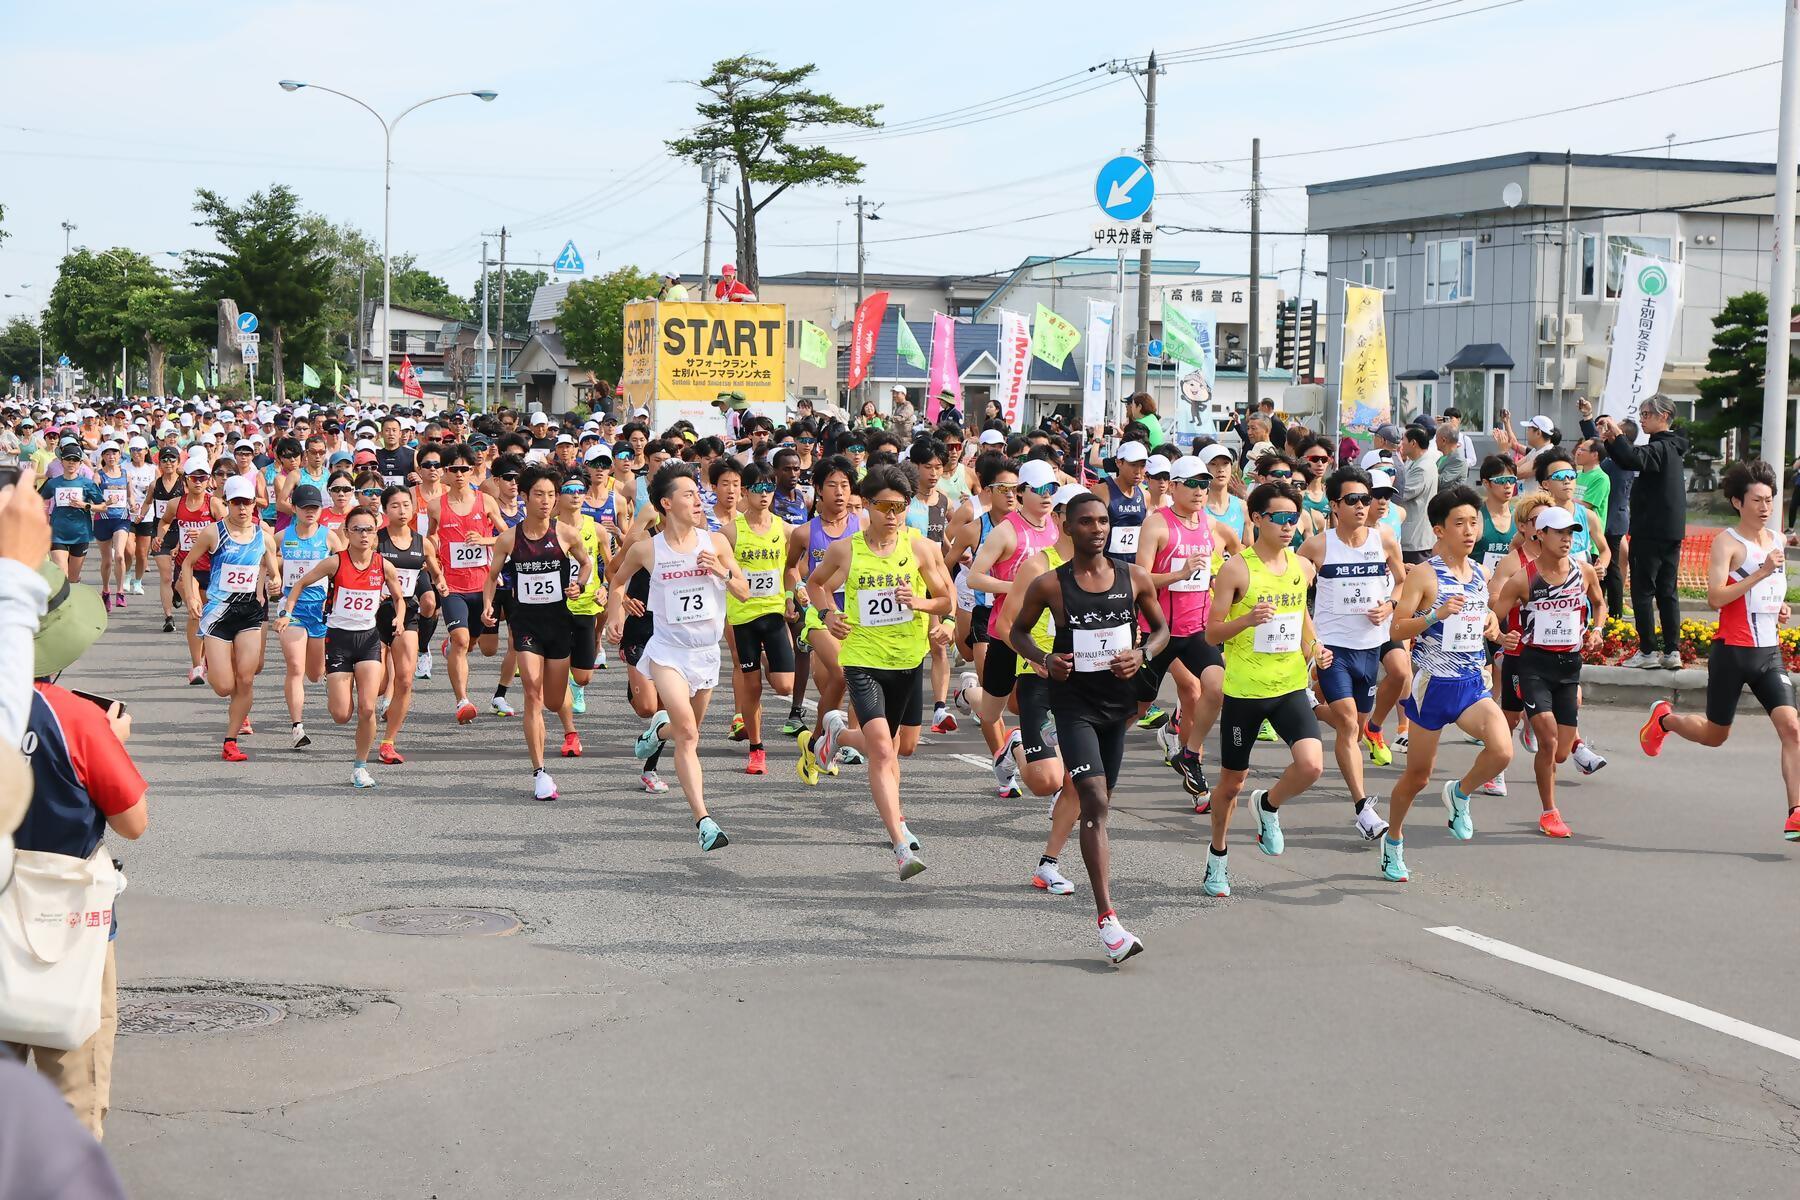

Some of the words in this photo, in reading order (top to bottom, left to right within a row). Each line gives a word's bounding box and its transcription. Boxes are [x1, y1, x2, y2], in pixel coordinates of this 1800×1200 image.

[1094, 227, 1153, 244] 中央分離帯
[626, 316, 655, 357] START
[663, 317, 781, 357] START
[686, 358, 758, 369] サフォークランド
[672, 368, 772, 379] 士別ハーフマラソン大会
[177, 519, 212, 529] Canon
[1120, 533, 1134, 545] 42
[456, 547, 483, 561] 202
[298, 566, 305, 574] 8
[661, 568, 713, 580] HONDA
[1335, 564, 1379, 576] 旭化成
[227, 571, 255, 585] 254
[747, 577, 774, 590] 123
[858, 573, 911, 588] 中央学院大学
[524, 580, 555, 595] 125
[1354, 588, 1361, 598] 3
[343, 596, 374, 611] 262
[679, 594, 704, 612] 73
[1534, 597, 1580, 611] TOYOTA
[1069, 608, 1133, 625] 上武大学
[1279, 623, 1286, 634] 6
[1466, 623, 1473, 634] 5
[1556, 620, 1562, 629] 2
[1100, 639, 1107, 650] 7
